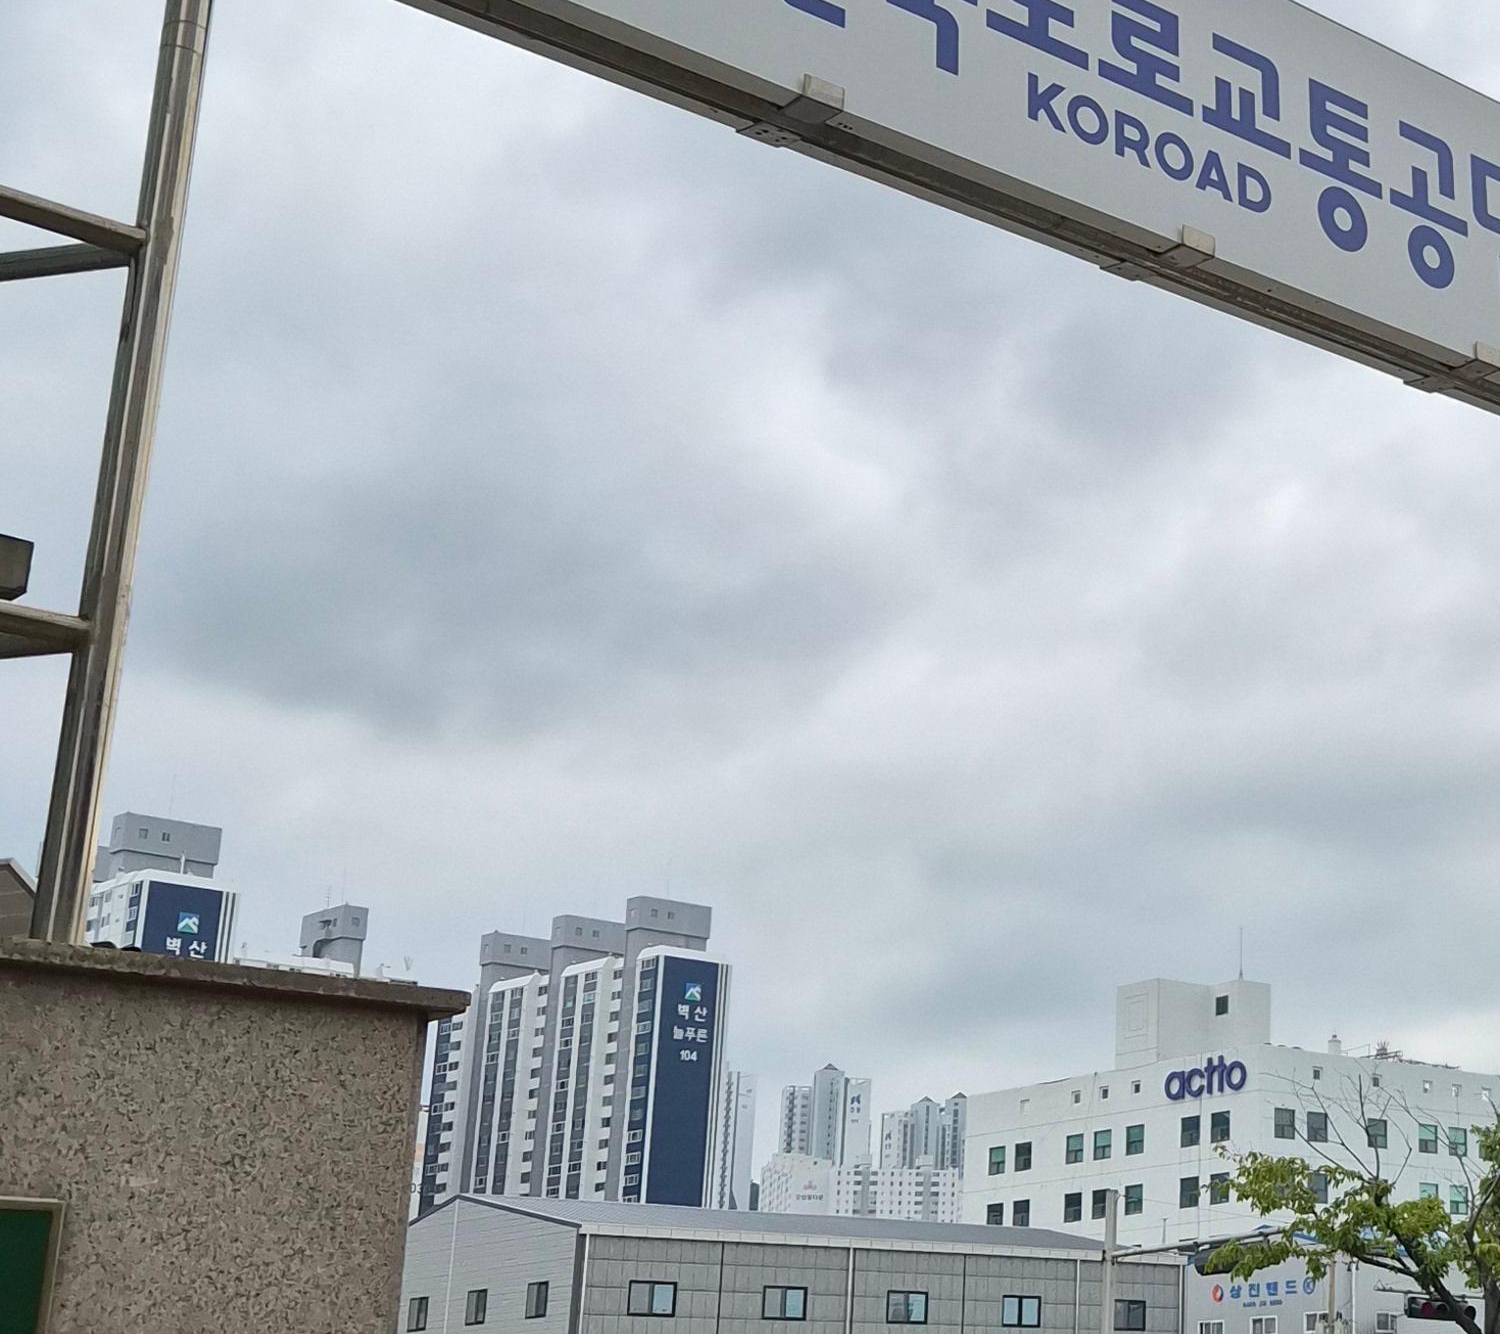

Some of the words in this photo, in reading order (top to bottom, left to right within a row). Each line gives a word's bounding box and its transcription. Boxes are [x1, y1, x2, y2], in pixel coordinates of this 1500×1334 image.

[1027, 71, 1272, 214] KOROAD
[678, 1004, 708, 1022] 벽산
[680, 1050, 698, 1062] 104
[1164, 1055, 1247, 1101] actto
